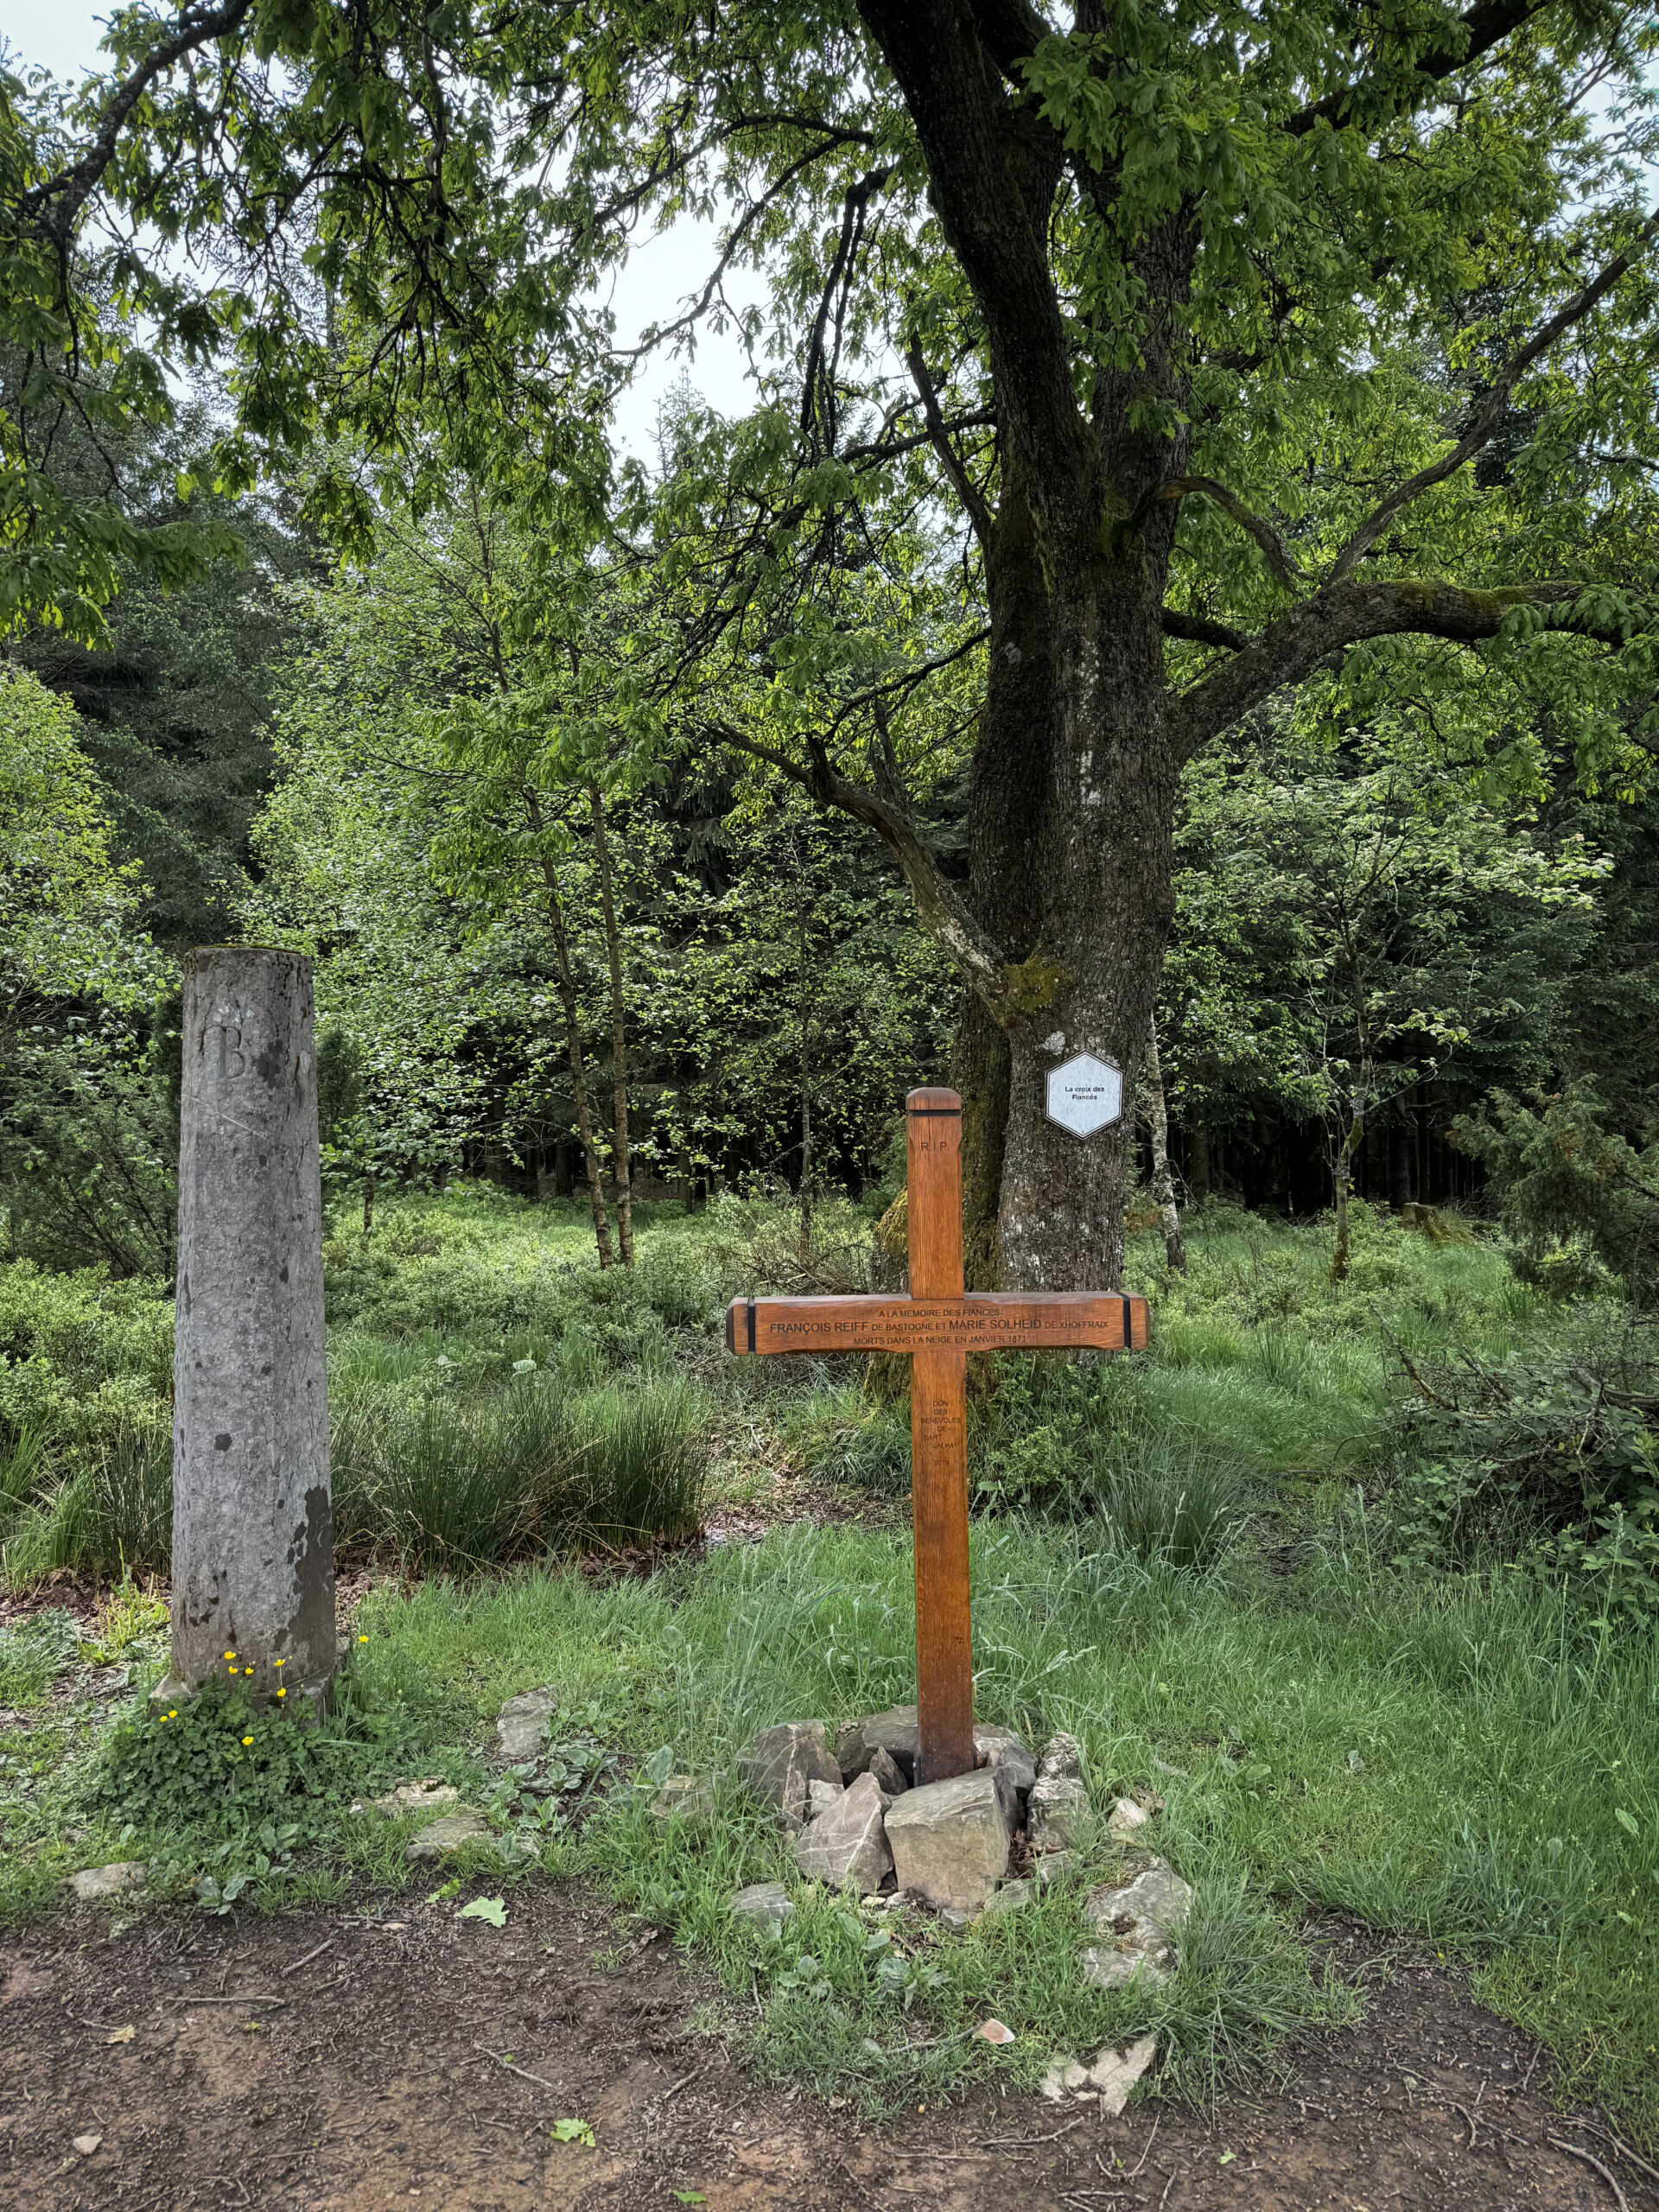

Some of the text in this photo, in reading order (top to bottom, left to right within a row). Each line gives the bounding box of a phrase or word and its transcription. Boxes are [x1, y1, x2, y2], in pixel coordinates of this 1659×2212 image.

[899, 1309, 941, 1318] MEMOIRE
[770, 1322, 831, 1335] FRANÇOIS
[834, 1321, 869, 1332] REIFF
[886, 1322, 934, 1332] BASTOGNE
[936, 1322, 946, 1331] ET
[949, 1319, 986, 1330] MARIE
[989, 1319, 1042, 1330] SOLHEID
[1045, 1320, 1058, 1329] DE
[854, 1337, 885, 1345] MORTS
[925, 1335, 952, 1344] NEIGE
[954, 1335, 967, 1344] EN
[969, 1334, 1005, 1343] JANVIER
[1007, 1334, 1026, 1343] 1871
